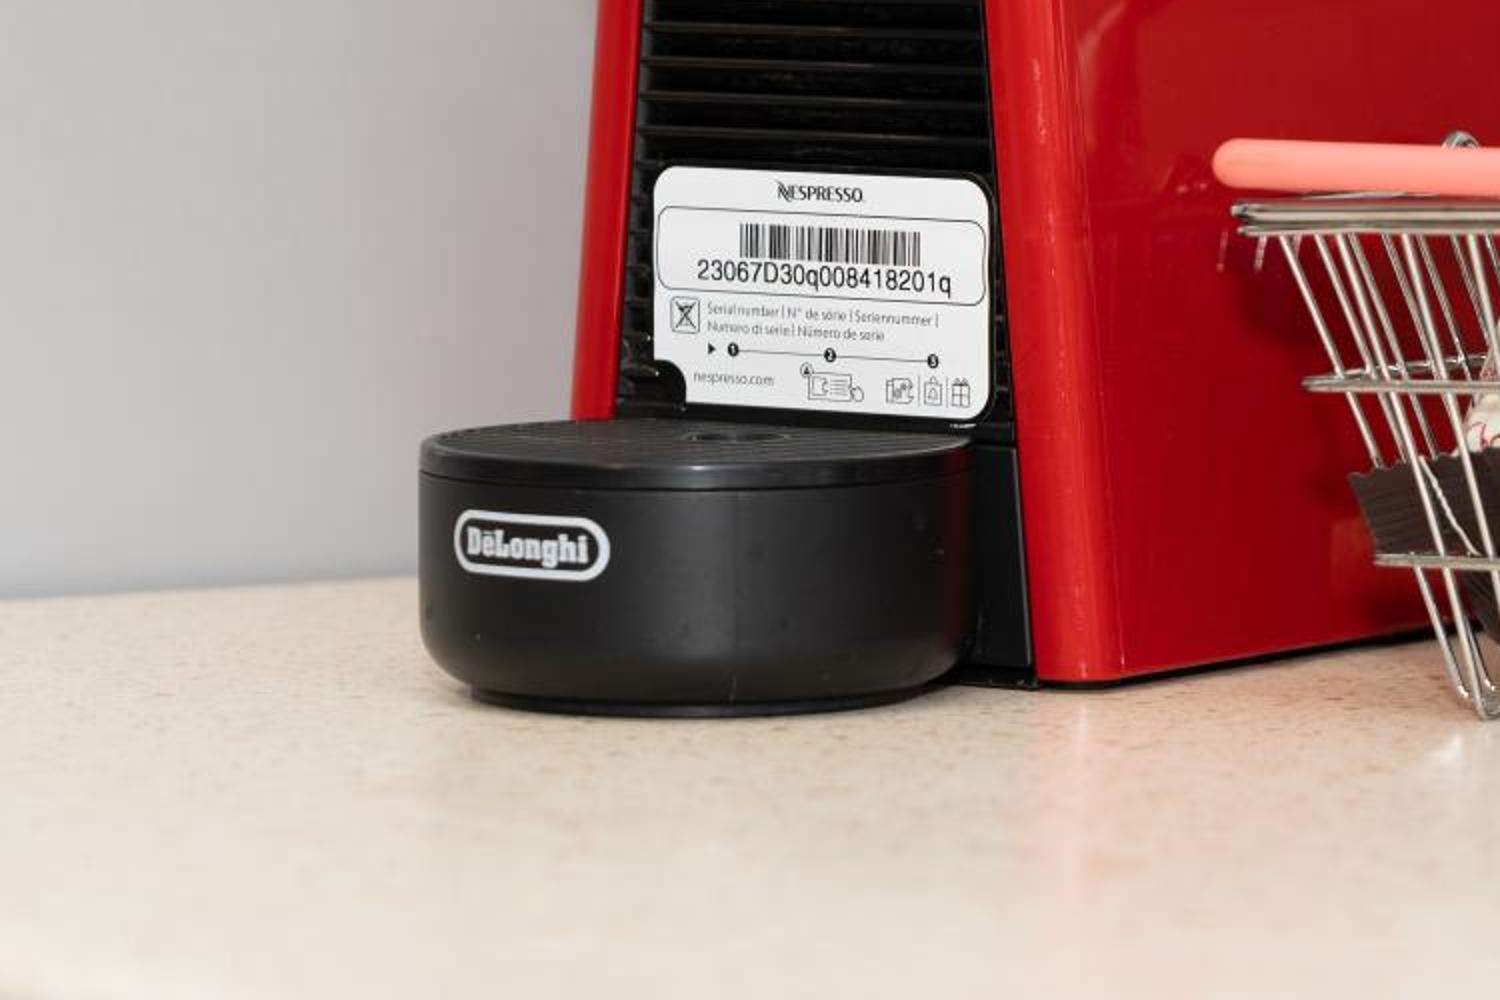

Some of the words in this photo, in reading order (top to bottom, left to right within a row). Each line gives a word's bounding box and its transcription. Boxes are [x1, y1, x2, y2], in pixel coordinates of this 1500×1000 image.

[776, 181, 864, 203] NESPRESSO
[697, 259, 951, 299] 23067D30q008418201q
[693, 371, 775, 387] nespresso.com
